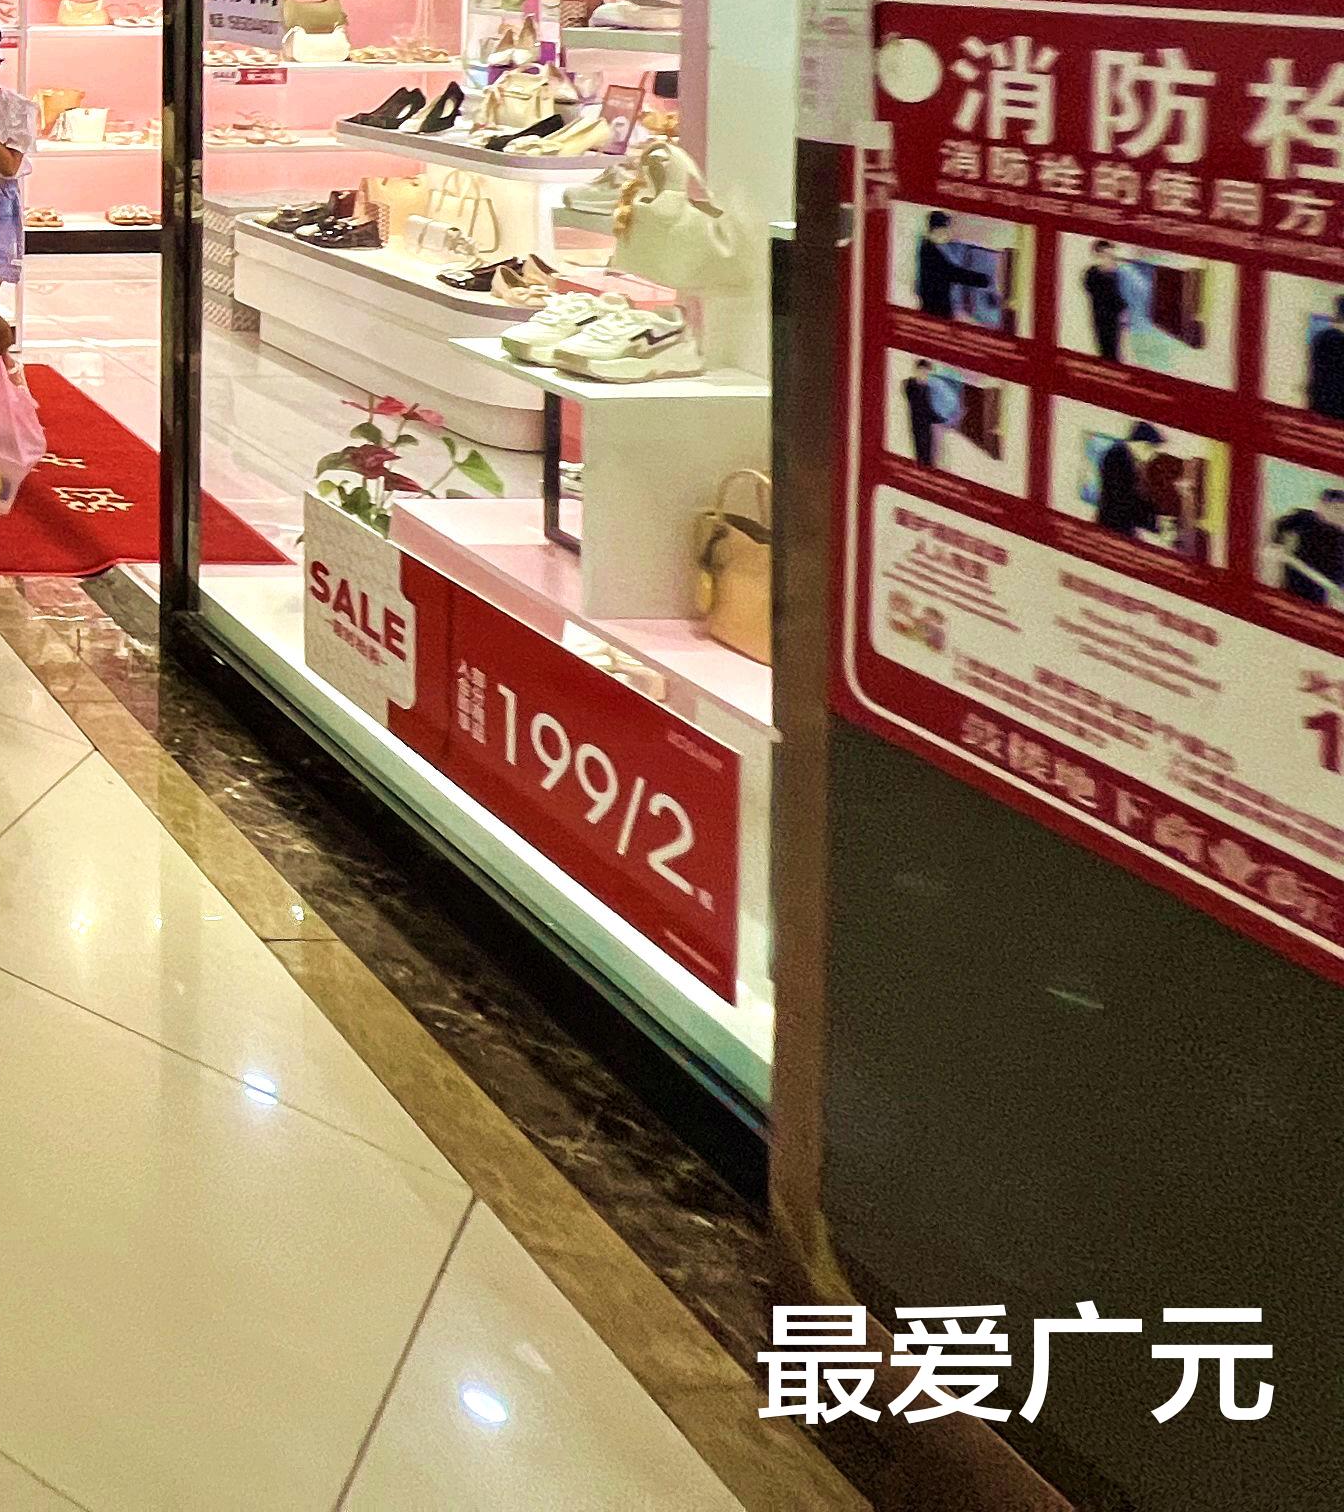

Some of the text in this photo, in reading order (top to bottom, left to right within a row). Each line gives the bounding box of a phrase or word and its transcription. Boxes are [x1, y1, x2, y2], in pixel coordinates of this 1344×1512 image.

[951, 35, 1344, 181] 消防栓
[310, 560, 407, 663] SALE
